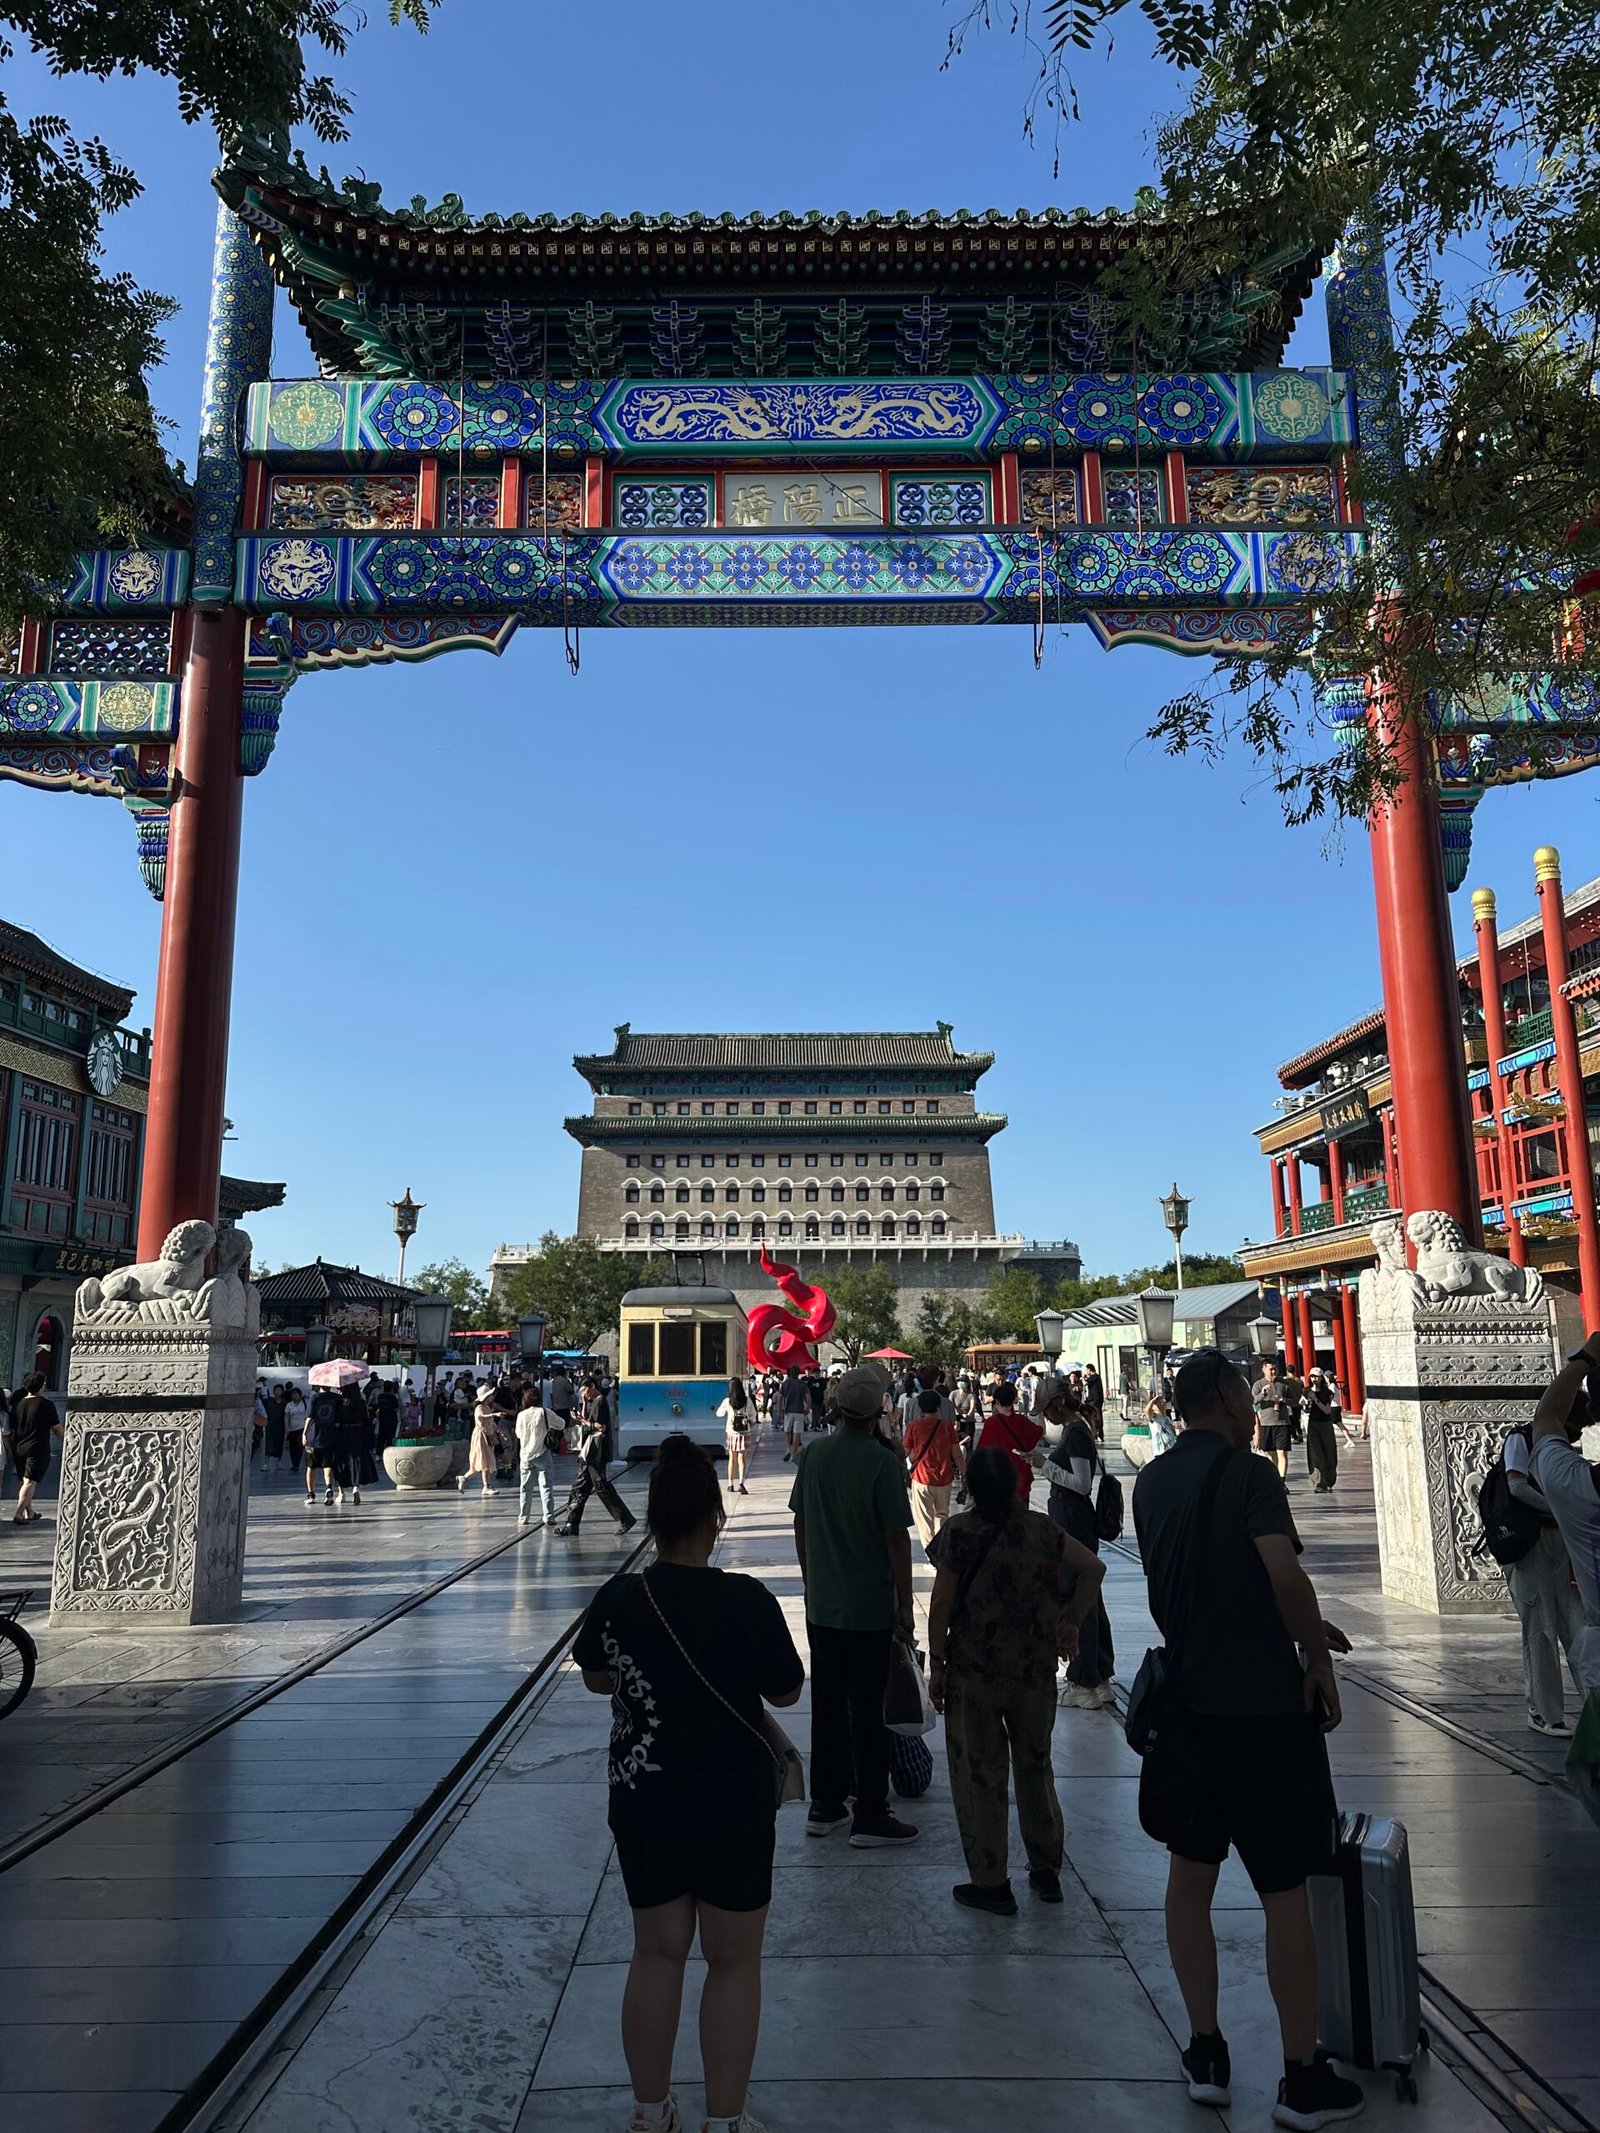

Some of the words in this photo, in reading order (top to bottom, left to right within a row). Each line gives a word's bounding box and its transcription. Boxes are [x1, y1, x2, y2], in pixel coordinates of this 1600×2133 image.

[730, 484, 873, 525] 正陽橋
[56, 1250, 116, 1273] 星巴克咖啡
